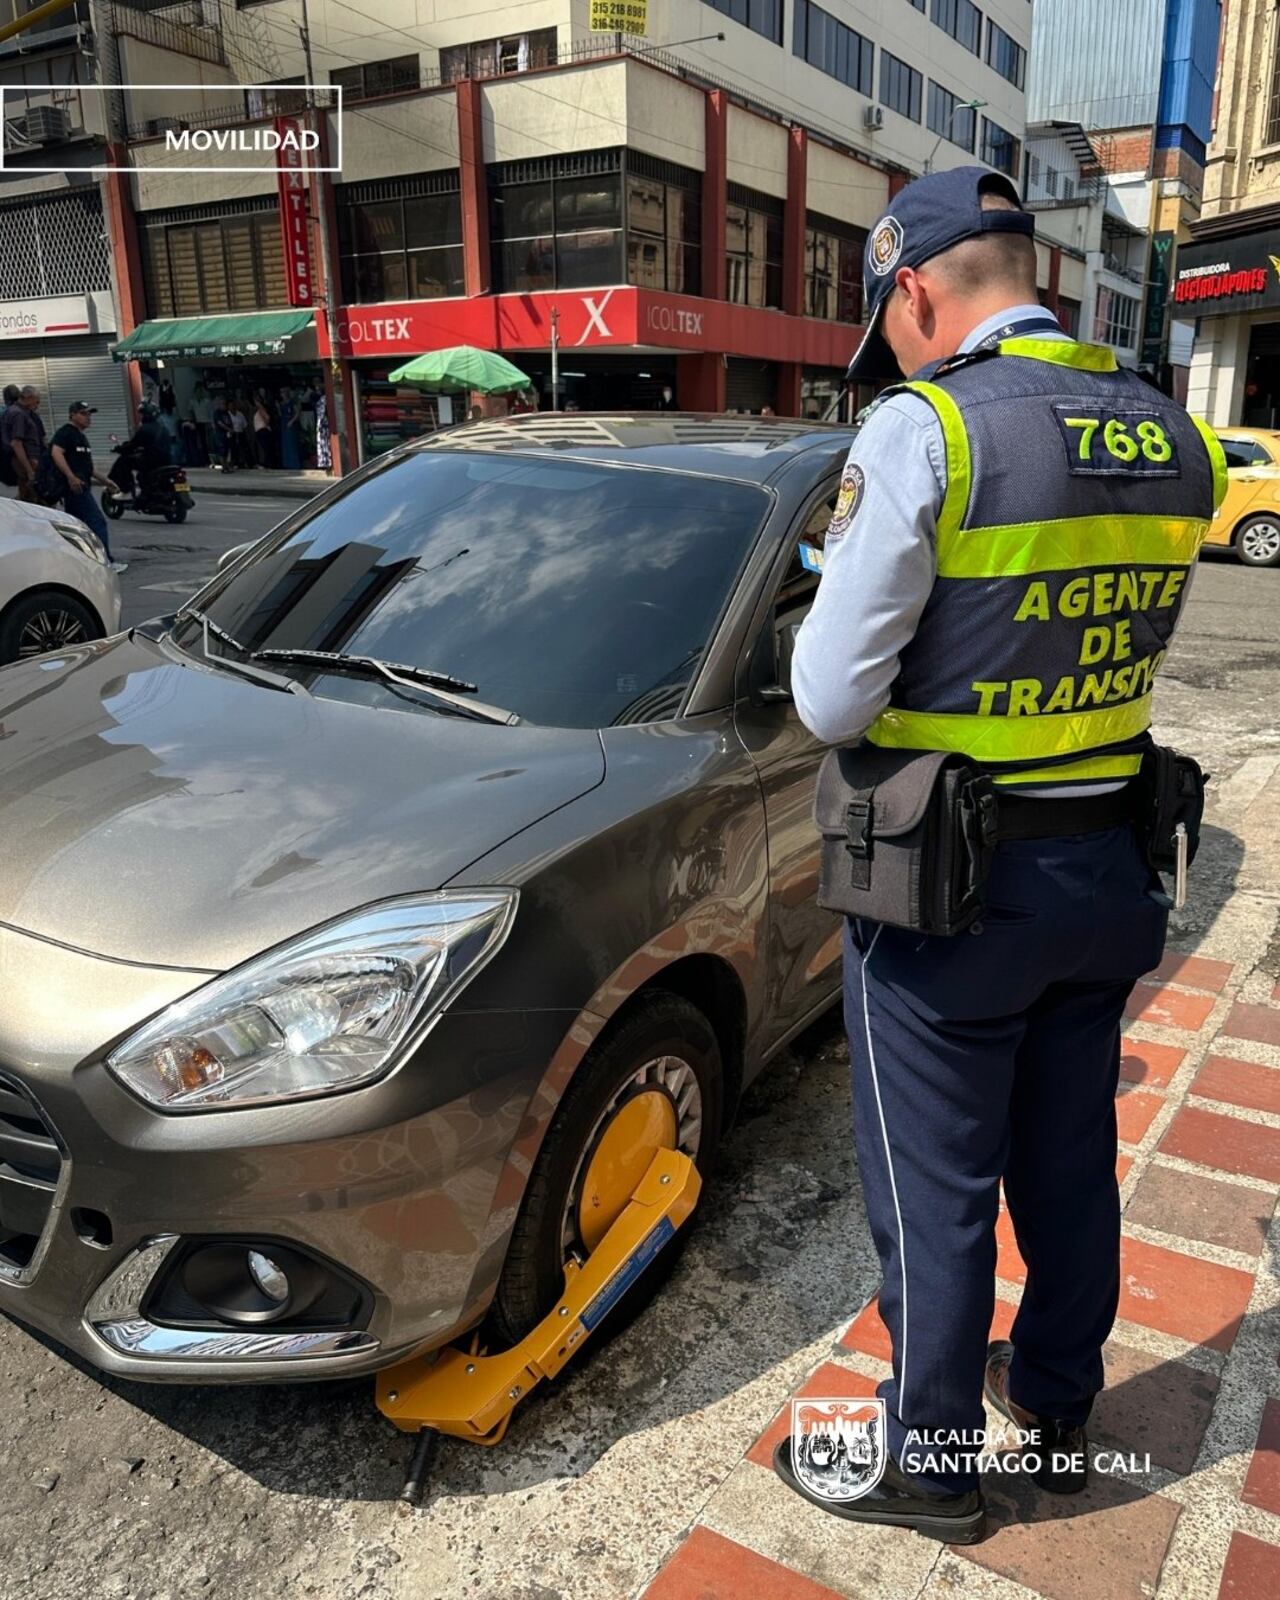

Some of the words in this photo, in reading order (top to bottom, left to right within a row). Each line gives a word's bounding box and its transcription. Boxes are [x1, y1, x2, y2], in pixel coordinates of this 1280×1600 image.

[593, 2, 608, 14] 315
[1179, 262, 1231, 279] DISTRIBUIDORA
[646, 305, 703, 335] ICOLTEX
[1063, 417, 1172, 462] 768
[1013, 570, 1186, 622] AGENTE
[1078, 619, 1131, 666] DE
